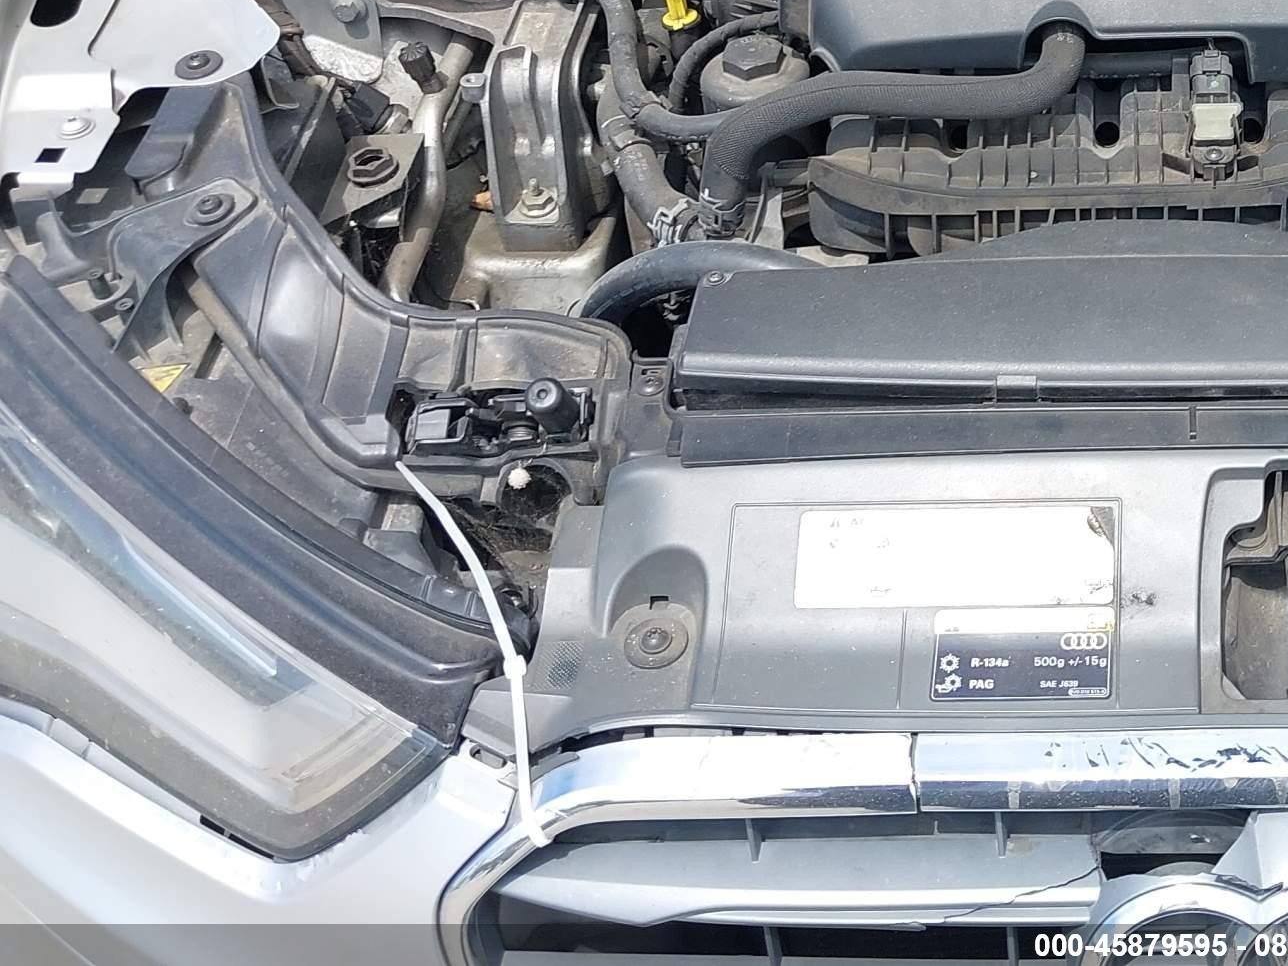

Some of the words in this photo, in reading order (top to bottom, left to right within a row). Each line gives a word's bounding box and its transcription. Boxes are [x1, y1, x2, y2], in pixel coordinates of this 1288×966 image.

[970, 657, 1010, 668] R-134a
[1034, 656, 1065, 669] 500g
[969, 679, 995, 690] PAG
[1040, 680, 1058, 688] SAE
[1058, 680, 1079, 688] J639
